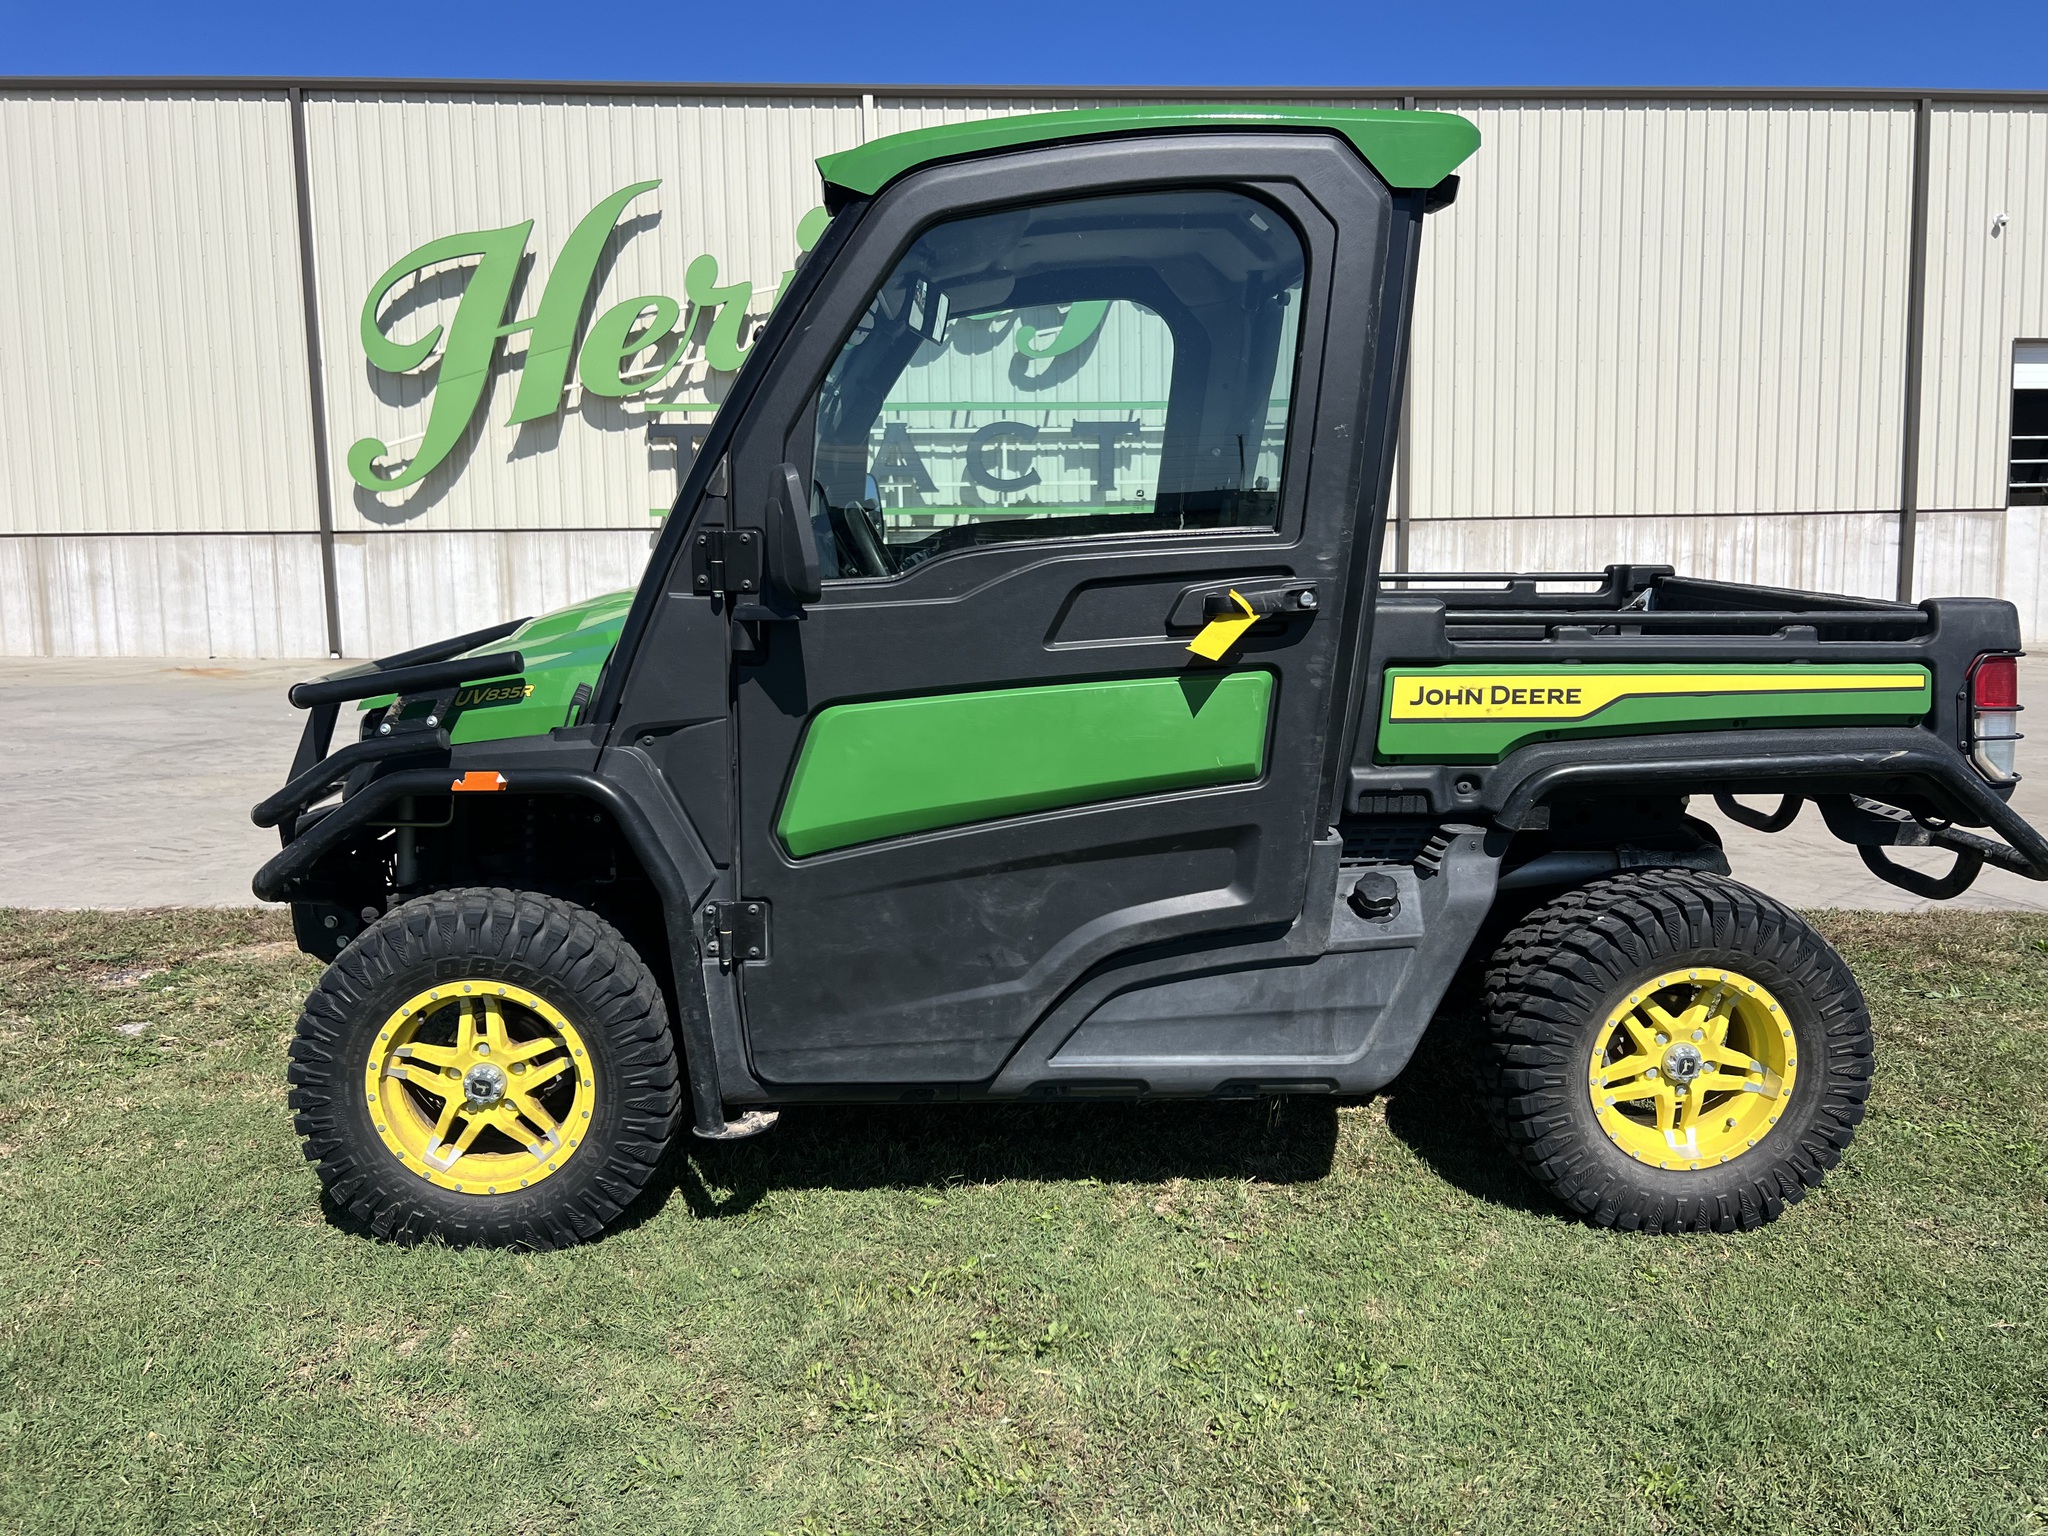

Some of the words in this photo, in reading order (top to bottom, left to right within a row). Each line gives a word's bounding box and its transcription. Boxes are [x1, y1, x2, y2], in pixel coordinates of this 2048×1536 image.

[454, 684, 536, 707] UV835R
[1409, 685, 1483, 706] JOHN
[1490, 685, 1582, 705] DEERE
